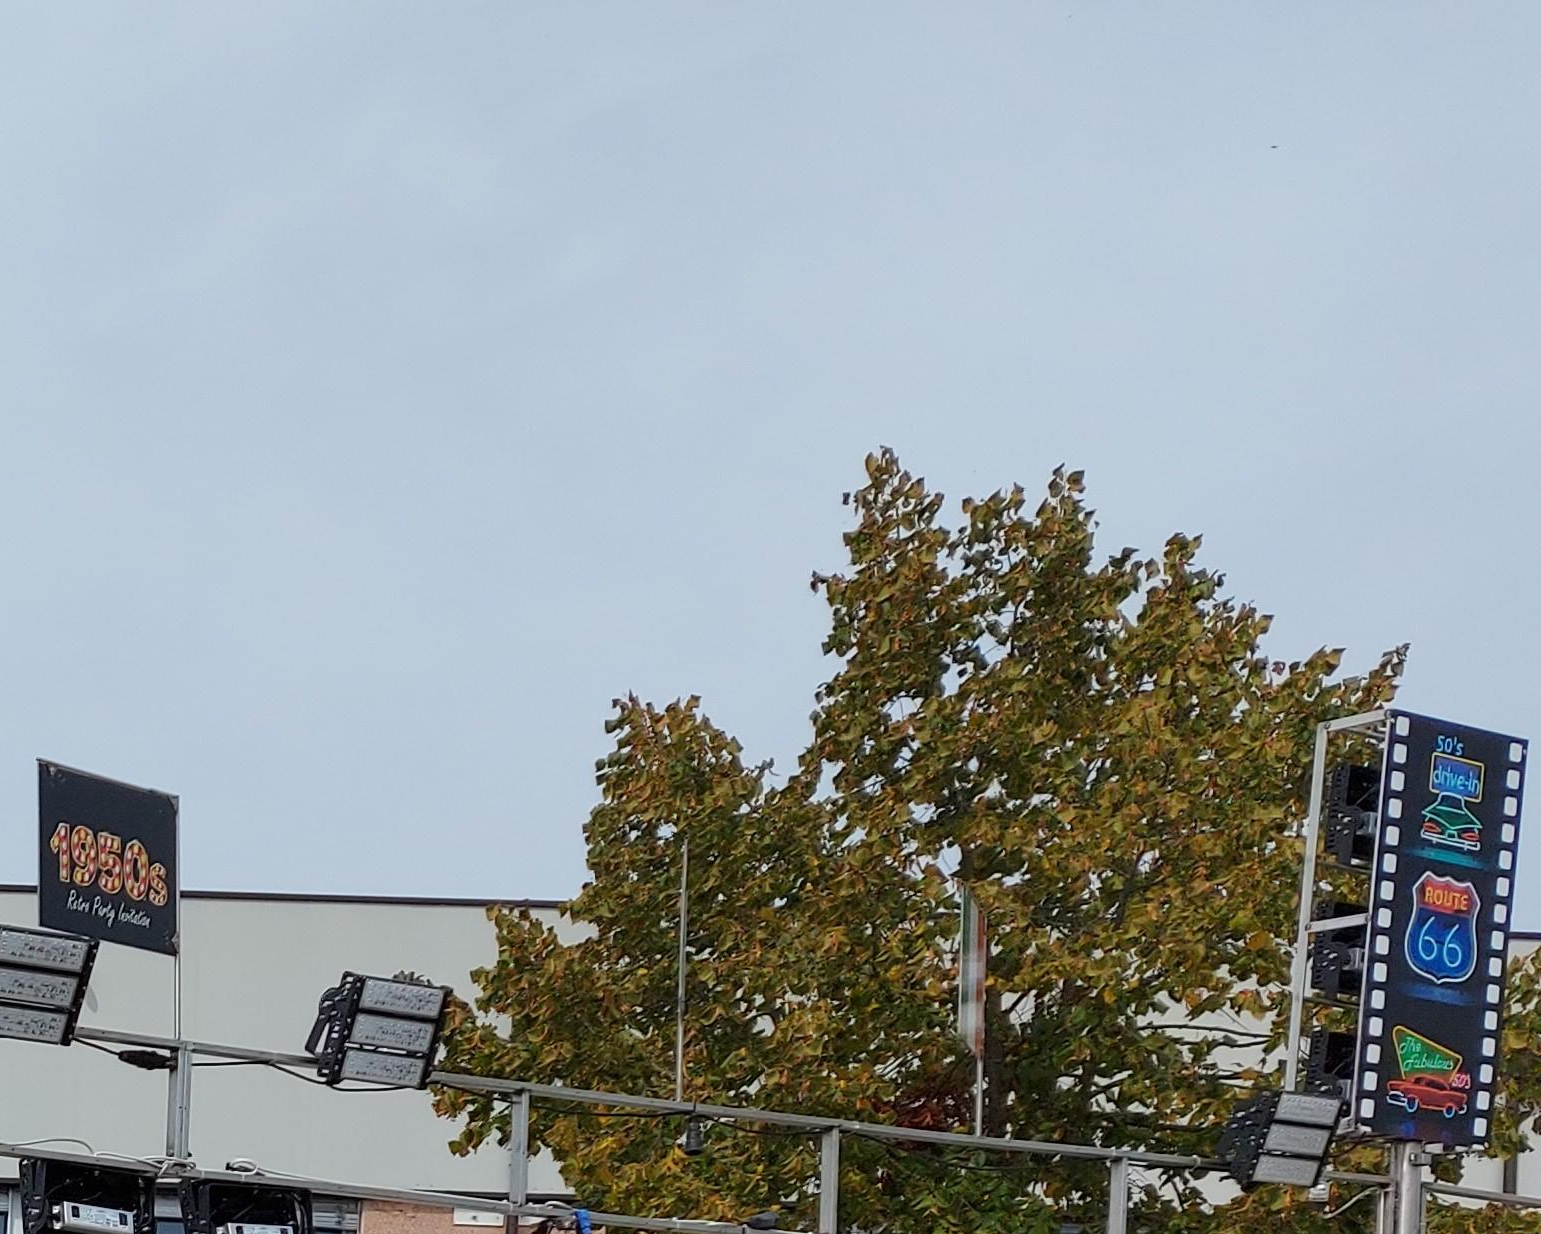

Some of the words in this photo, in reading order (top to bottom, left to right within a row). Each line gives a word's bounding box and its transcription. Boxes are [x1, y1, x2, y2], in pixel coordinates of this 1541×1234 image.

[67, 890, 90, 912] Retro
[92, 896, 115, 928] Party
[1424, 887, 1469, 910] ROUTE
[1418, 916, 1462, 967] 66
[1399, 1037, 1422, 1054] The
[1403, 1053, 1454, 1071] Fabulous
